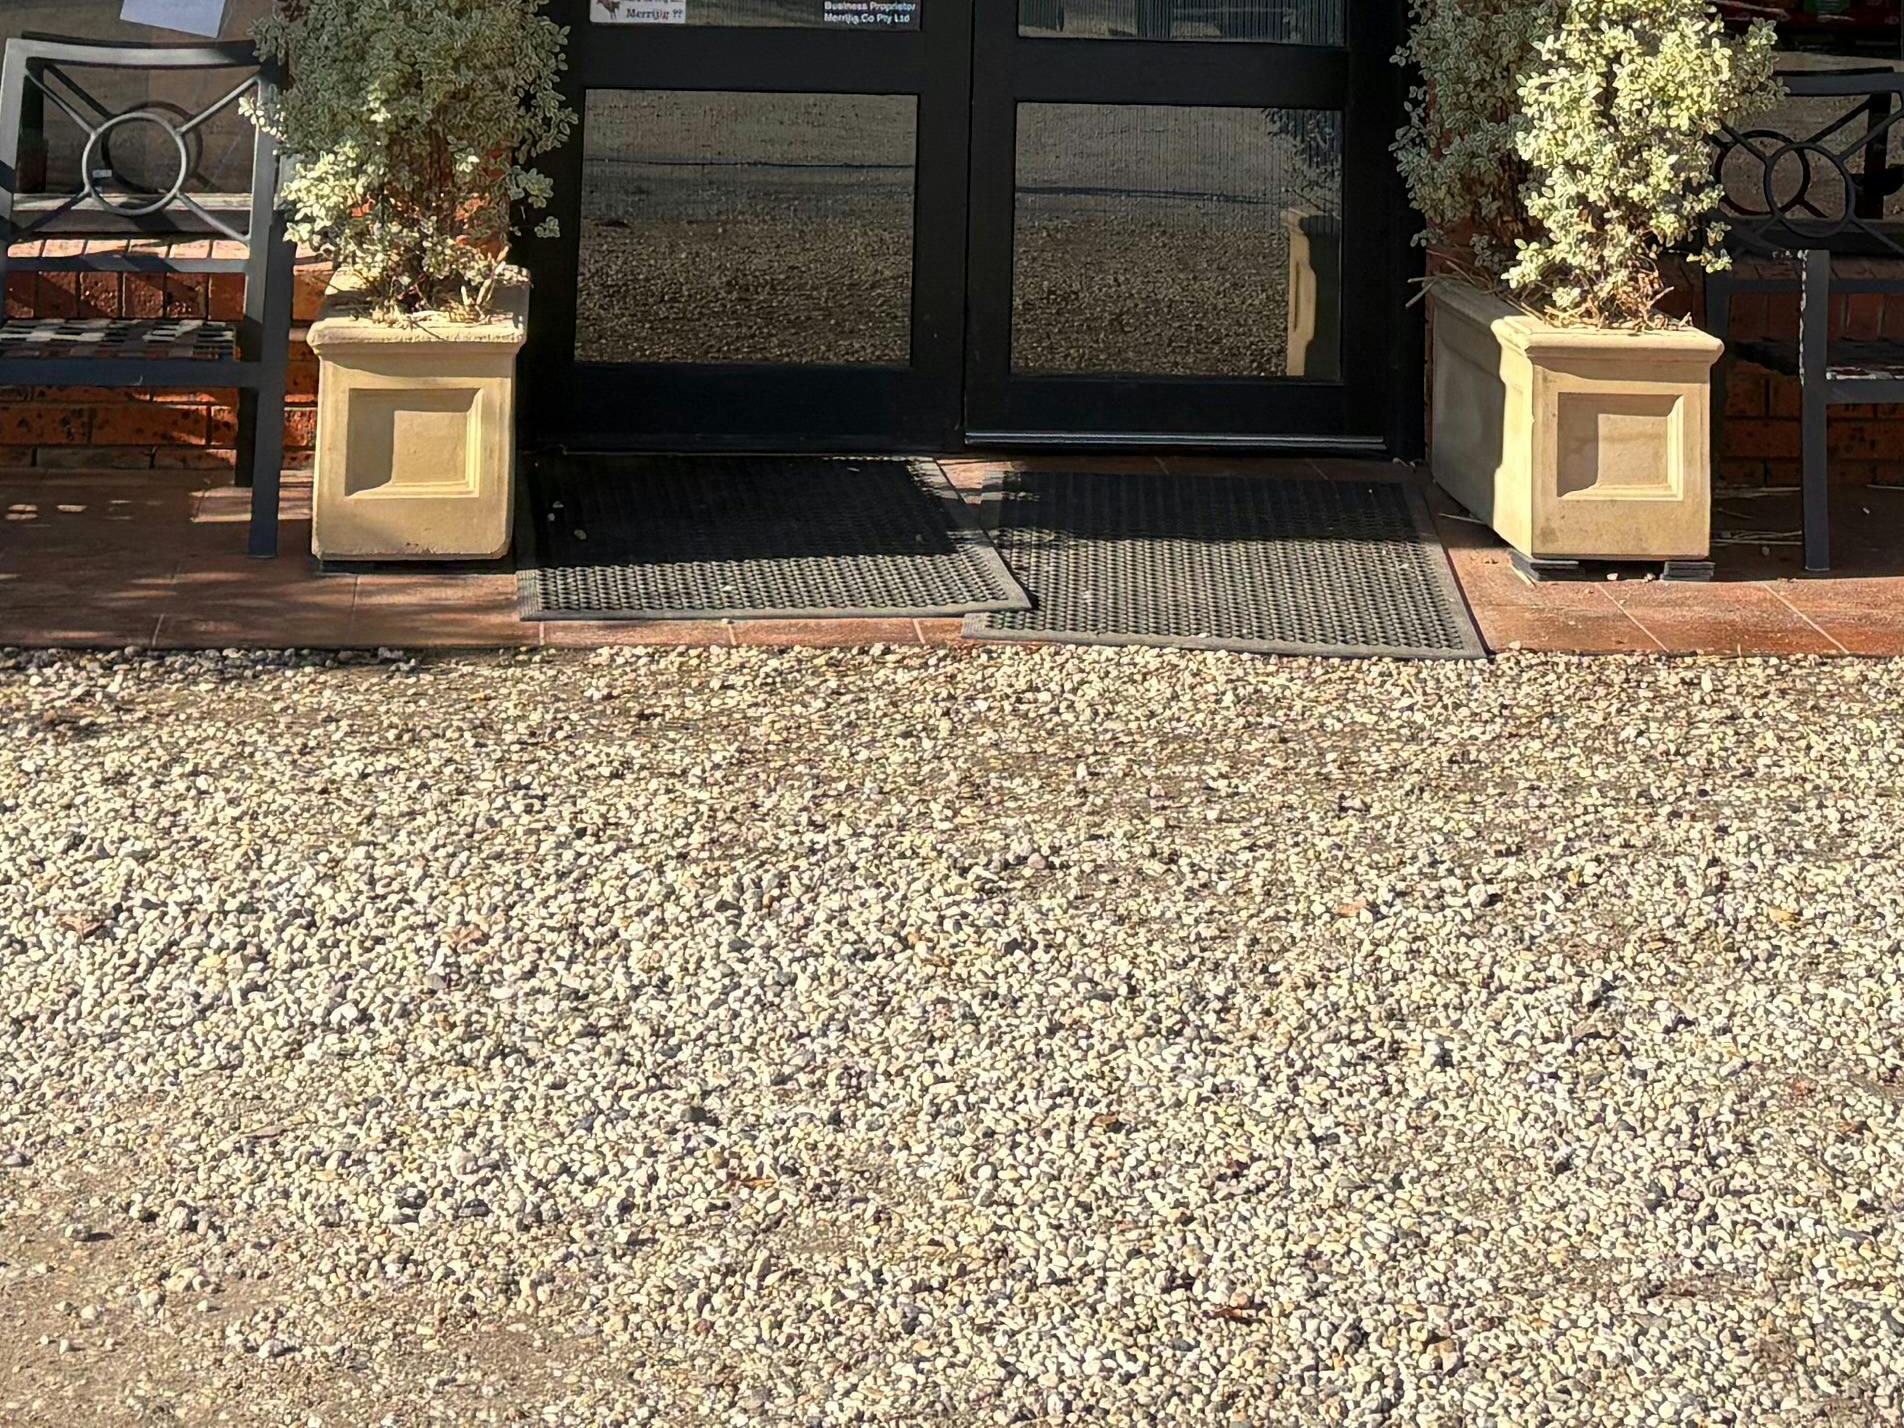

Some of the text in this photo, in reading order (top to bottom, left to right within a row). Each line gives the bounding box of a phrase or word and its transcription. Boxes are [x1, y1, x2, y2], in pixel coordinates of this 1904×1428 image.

[823, 1, 916, 12] Business Proprietor
[860, 13, 875, 23] Co
[876, 13, 893, 24] Pty
[894, 13, 911, 23] Ltd
